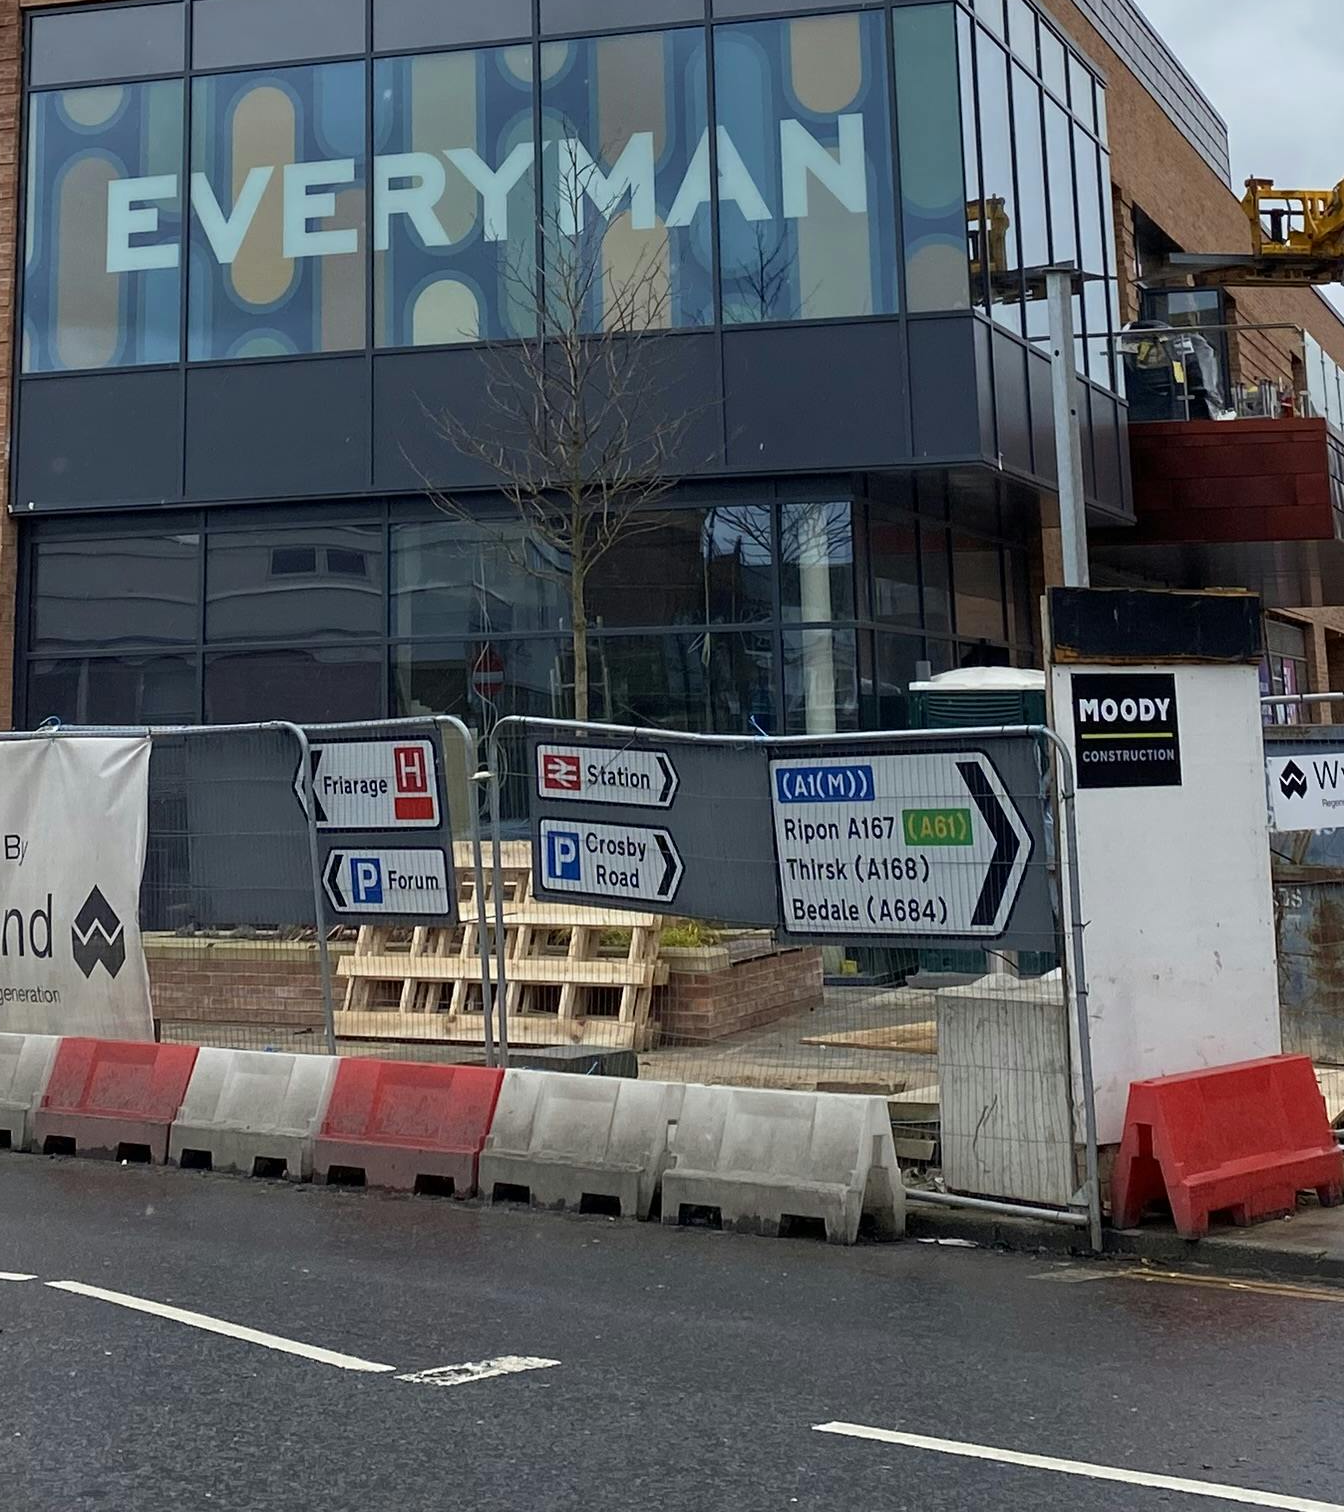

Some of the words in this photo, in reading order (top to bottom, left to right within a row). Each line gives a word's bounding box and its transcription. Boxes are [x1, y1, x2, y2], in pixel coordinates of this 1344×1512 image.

[106, 113, 867, 273] EVERYMAN
[1078, 698, 1170, 722] MOODY
[1082, 749, 1175, 762] CONSTRUCTION
[323, 775, 387, 797] Friarage
[587, 764, 650, 789] Station
[782, 768, 868, 799] (A1(M))
[784, 818, 839, 844] Ripon
[848, 816, 894, 840] A167
[907, 813, 967, 840] (A61)
[4, 834, 29, 867] By
[585, 832, 646, 862] Crosby
[388, 870, 439, 890] Forum
[596, 864, 639, 888] Road
[786, 858, 848, 881] Thirsk
[855, 854, 930, 883] (A168)
[792, 898, 859, 921] Bedale
[867, 896, 947, 925] (A684)
